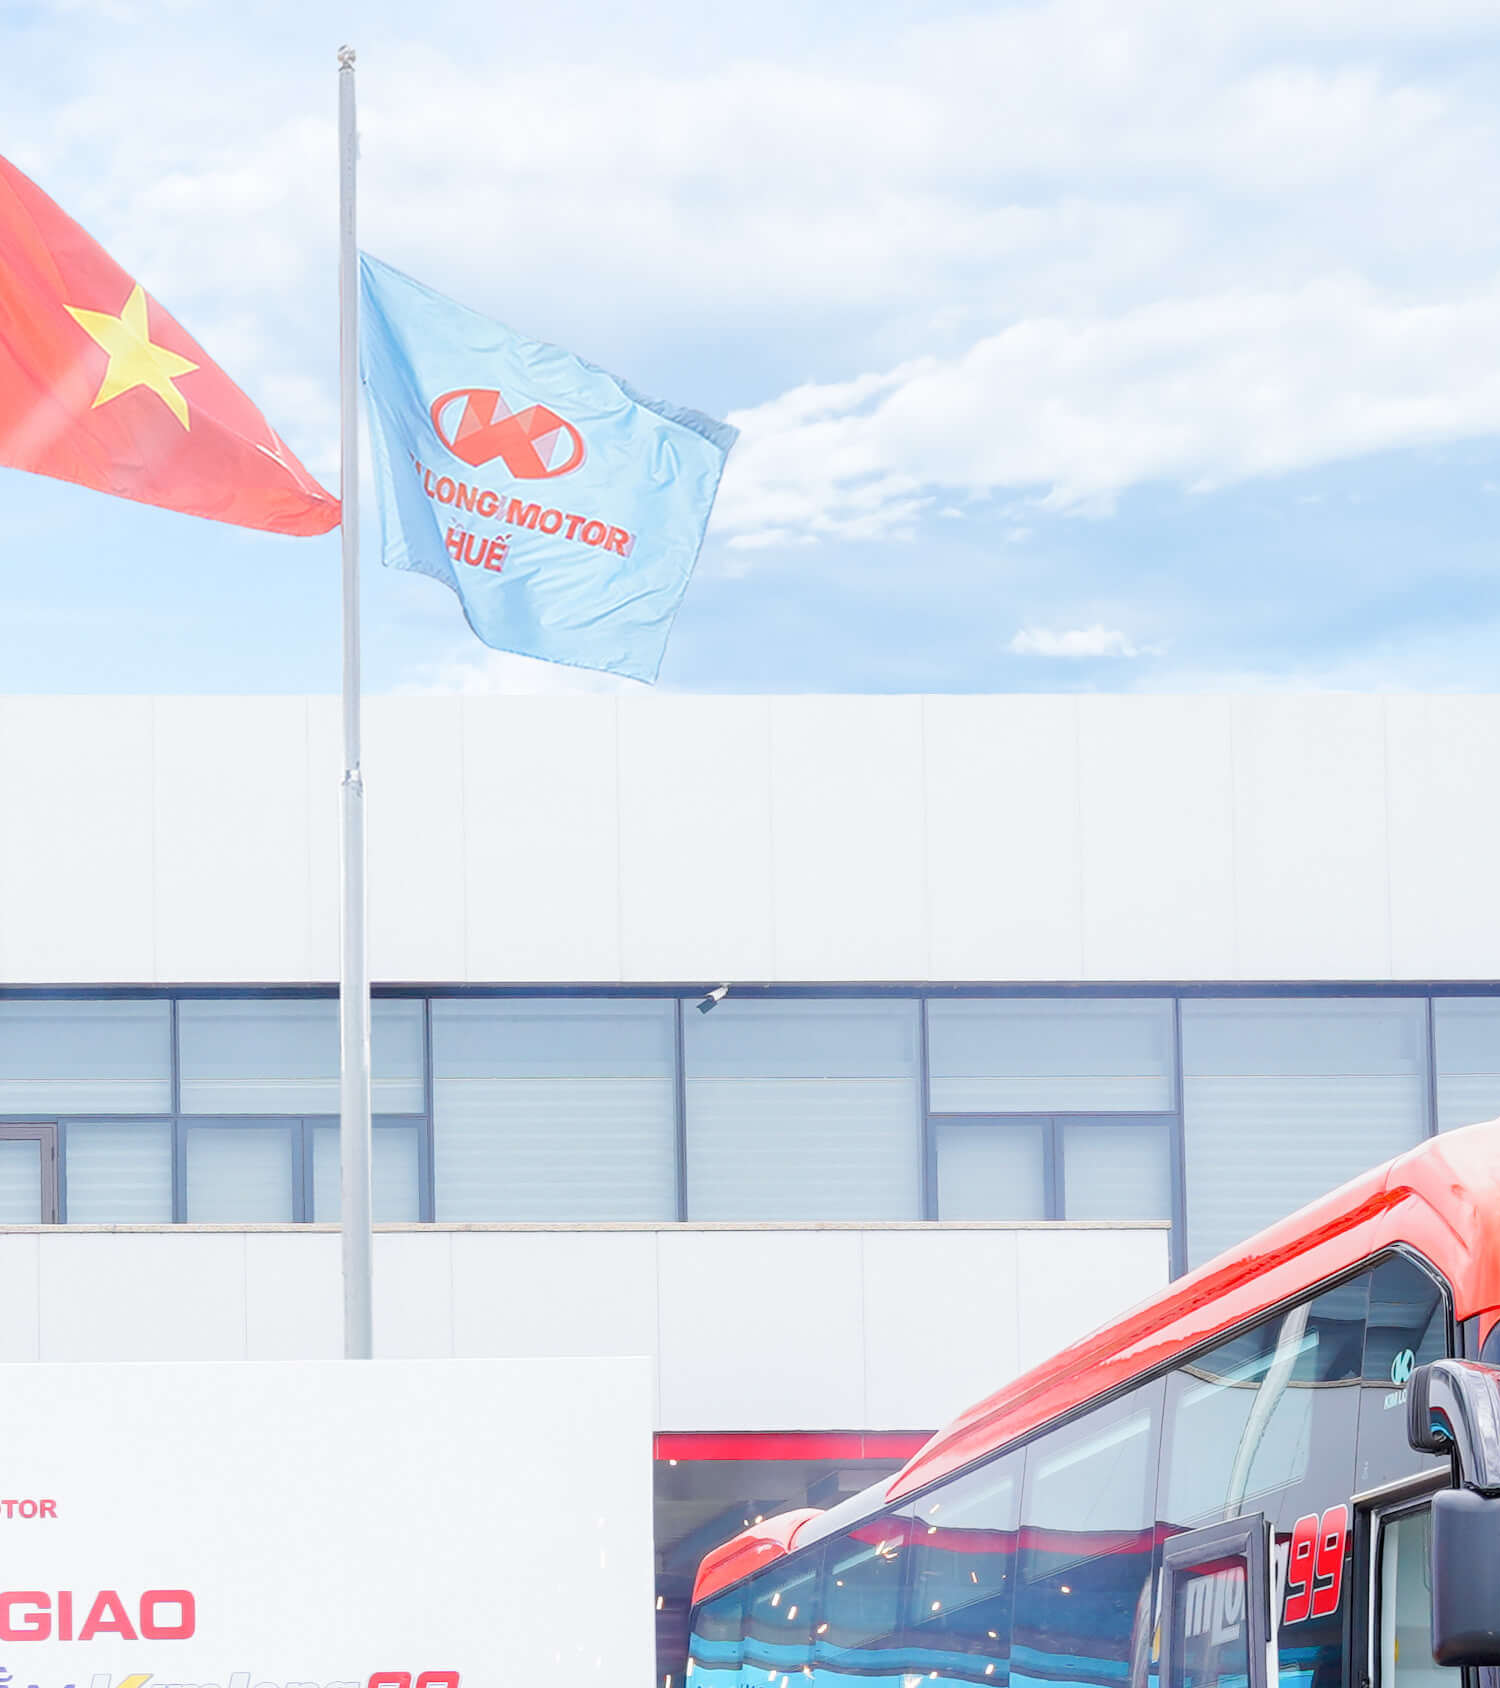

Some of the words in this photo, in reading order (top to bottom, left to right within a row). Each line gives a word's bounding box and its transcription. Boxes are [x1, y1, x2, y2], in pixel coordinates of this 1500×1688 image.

[424, 470, 501, 518] LONG
[504, 498, 633, 558] MOTOR
[446, 527, 511, 573] HUẾ
